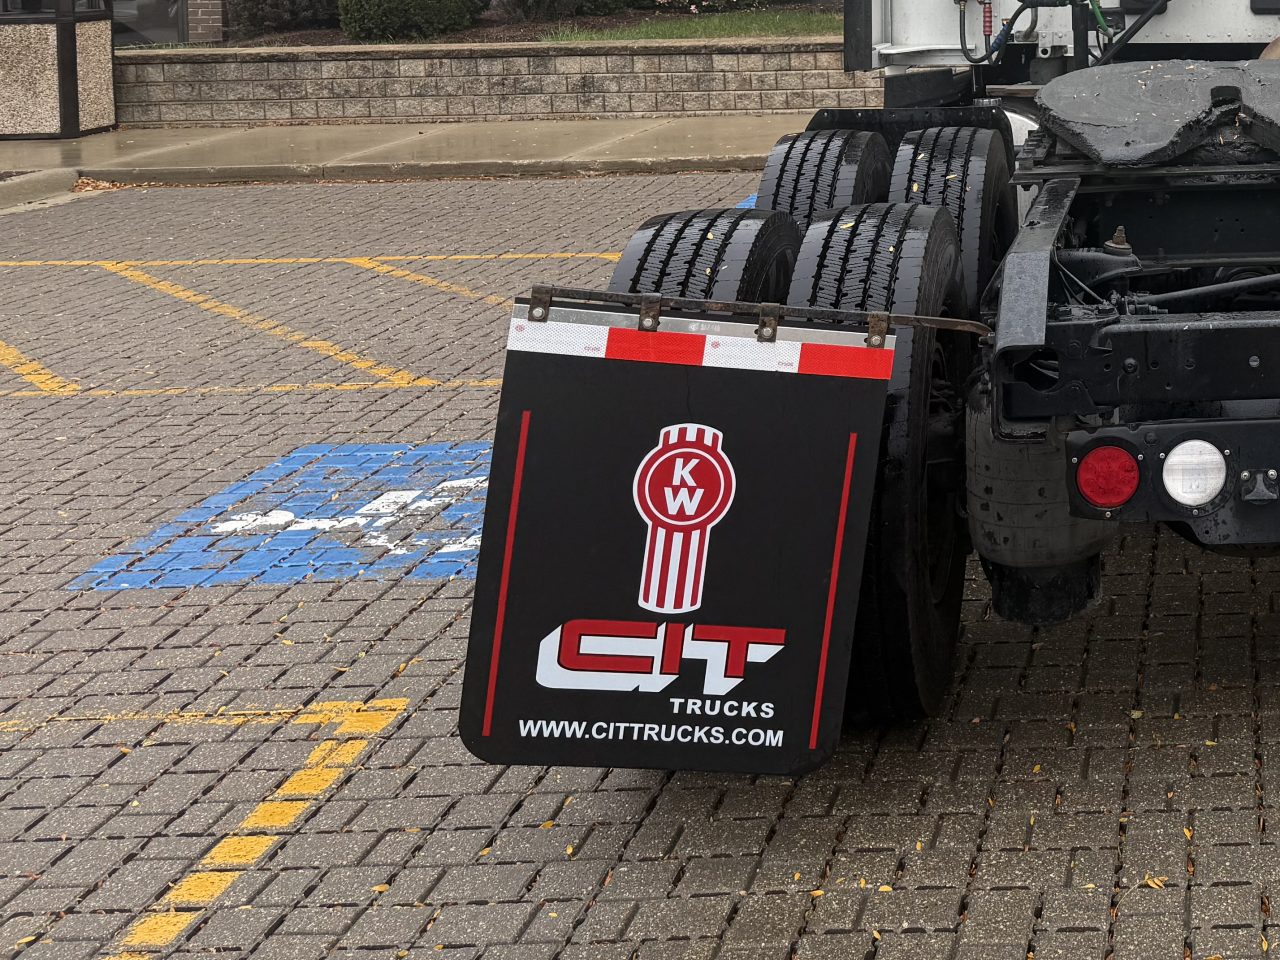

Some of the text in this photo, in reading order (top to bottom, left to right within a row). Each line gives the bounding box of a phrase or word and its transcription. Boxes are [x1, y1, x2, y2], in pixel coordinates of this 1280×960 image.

[536, 619, 786, 695] CIT
[670, 697, 775, 718] TRUCKS
[518, 719, 785, 747] WWW.CITTRUCKS.COM
